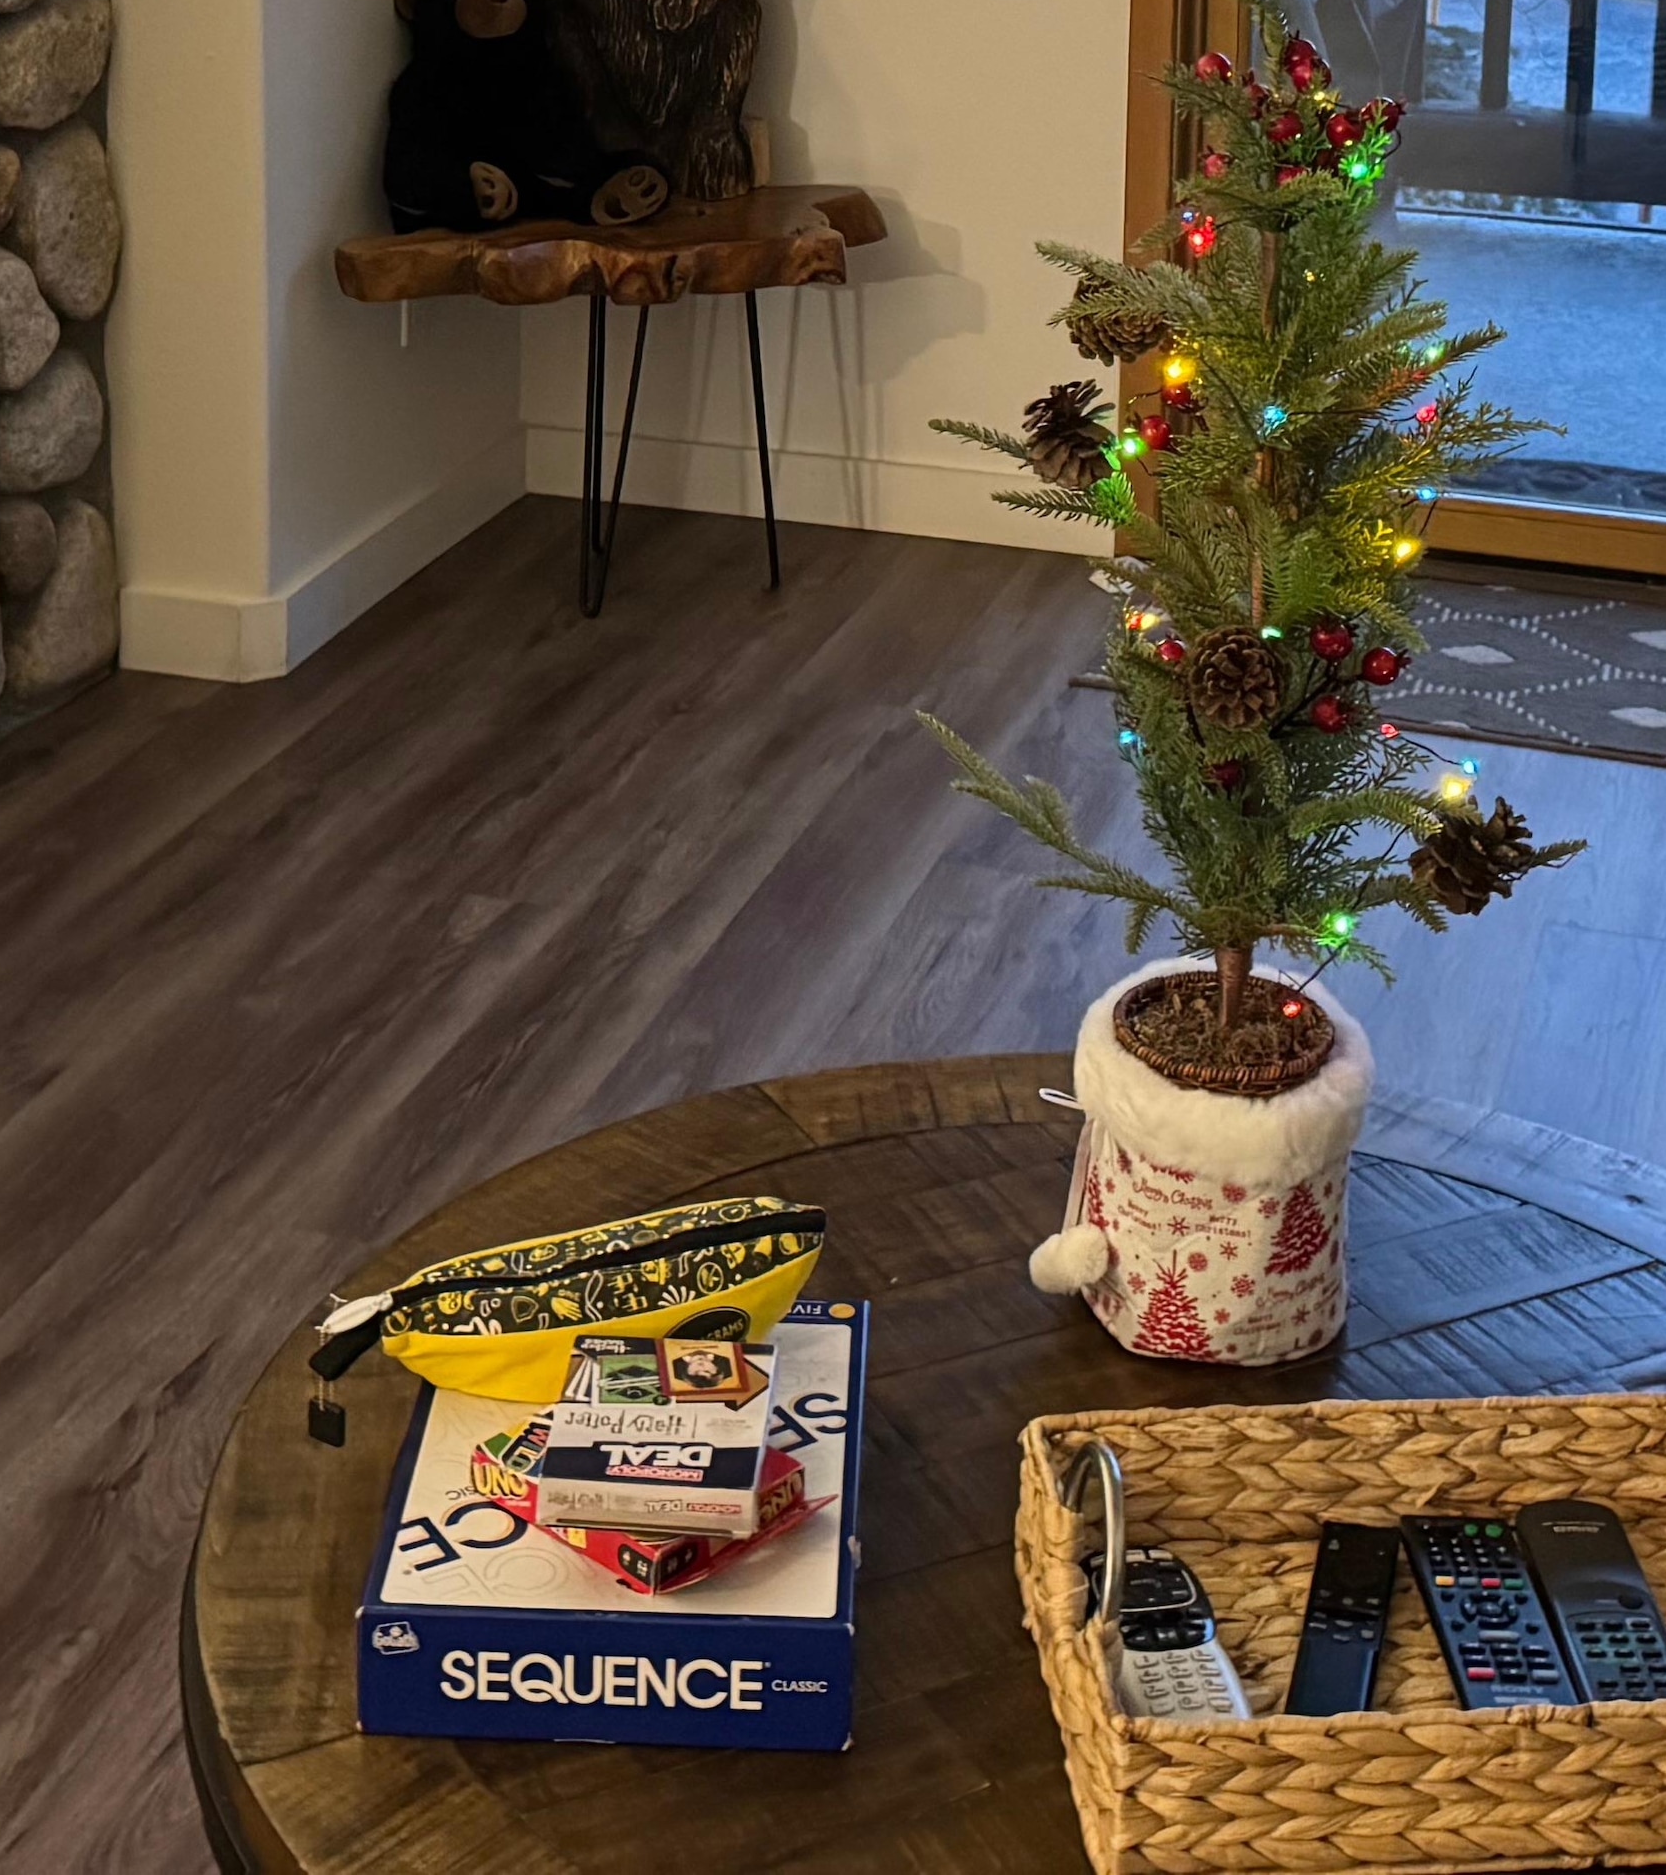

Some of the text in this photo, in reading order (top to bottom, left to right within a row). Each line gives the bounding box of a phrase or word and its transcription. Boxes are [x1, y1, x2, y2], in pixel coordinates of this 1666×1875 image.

[793, 1304, 822, 1315] FIV
[564, 1408, 625, 1435] Potter
[627, 1413, 687, 1436] Harry
[600, 1444, 714, 1467] DEAL
[472, 1463, 529, 1498] UNO
[606, 1465, 704, 1482] MONOPOLY
[646, 1499, 683, 1514] DEAL
[687, 1503, 742, 1514] MONOPOLY
[440, 1649, 829, 1711] SEQUENCE CLASSIC
